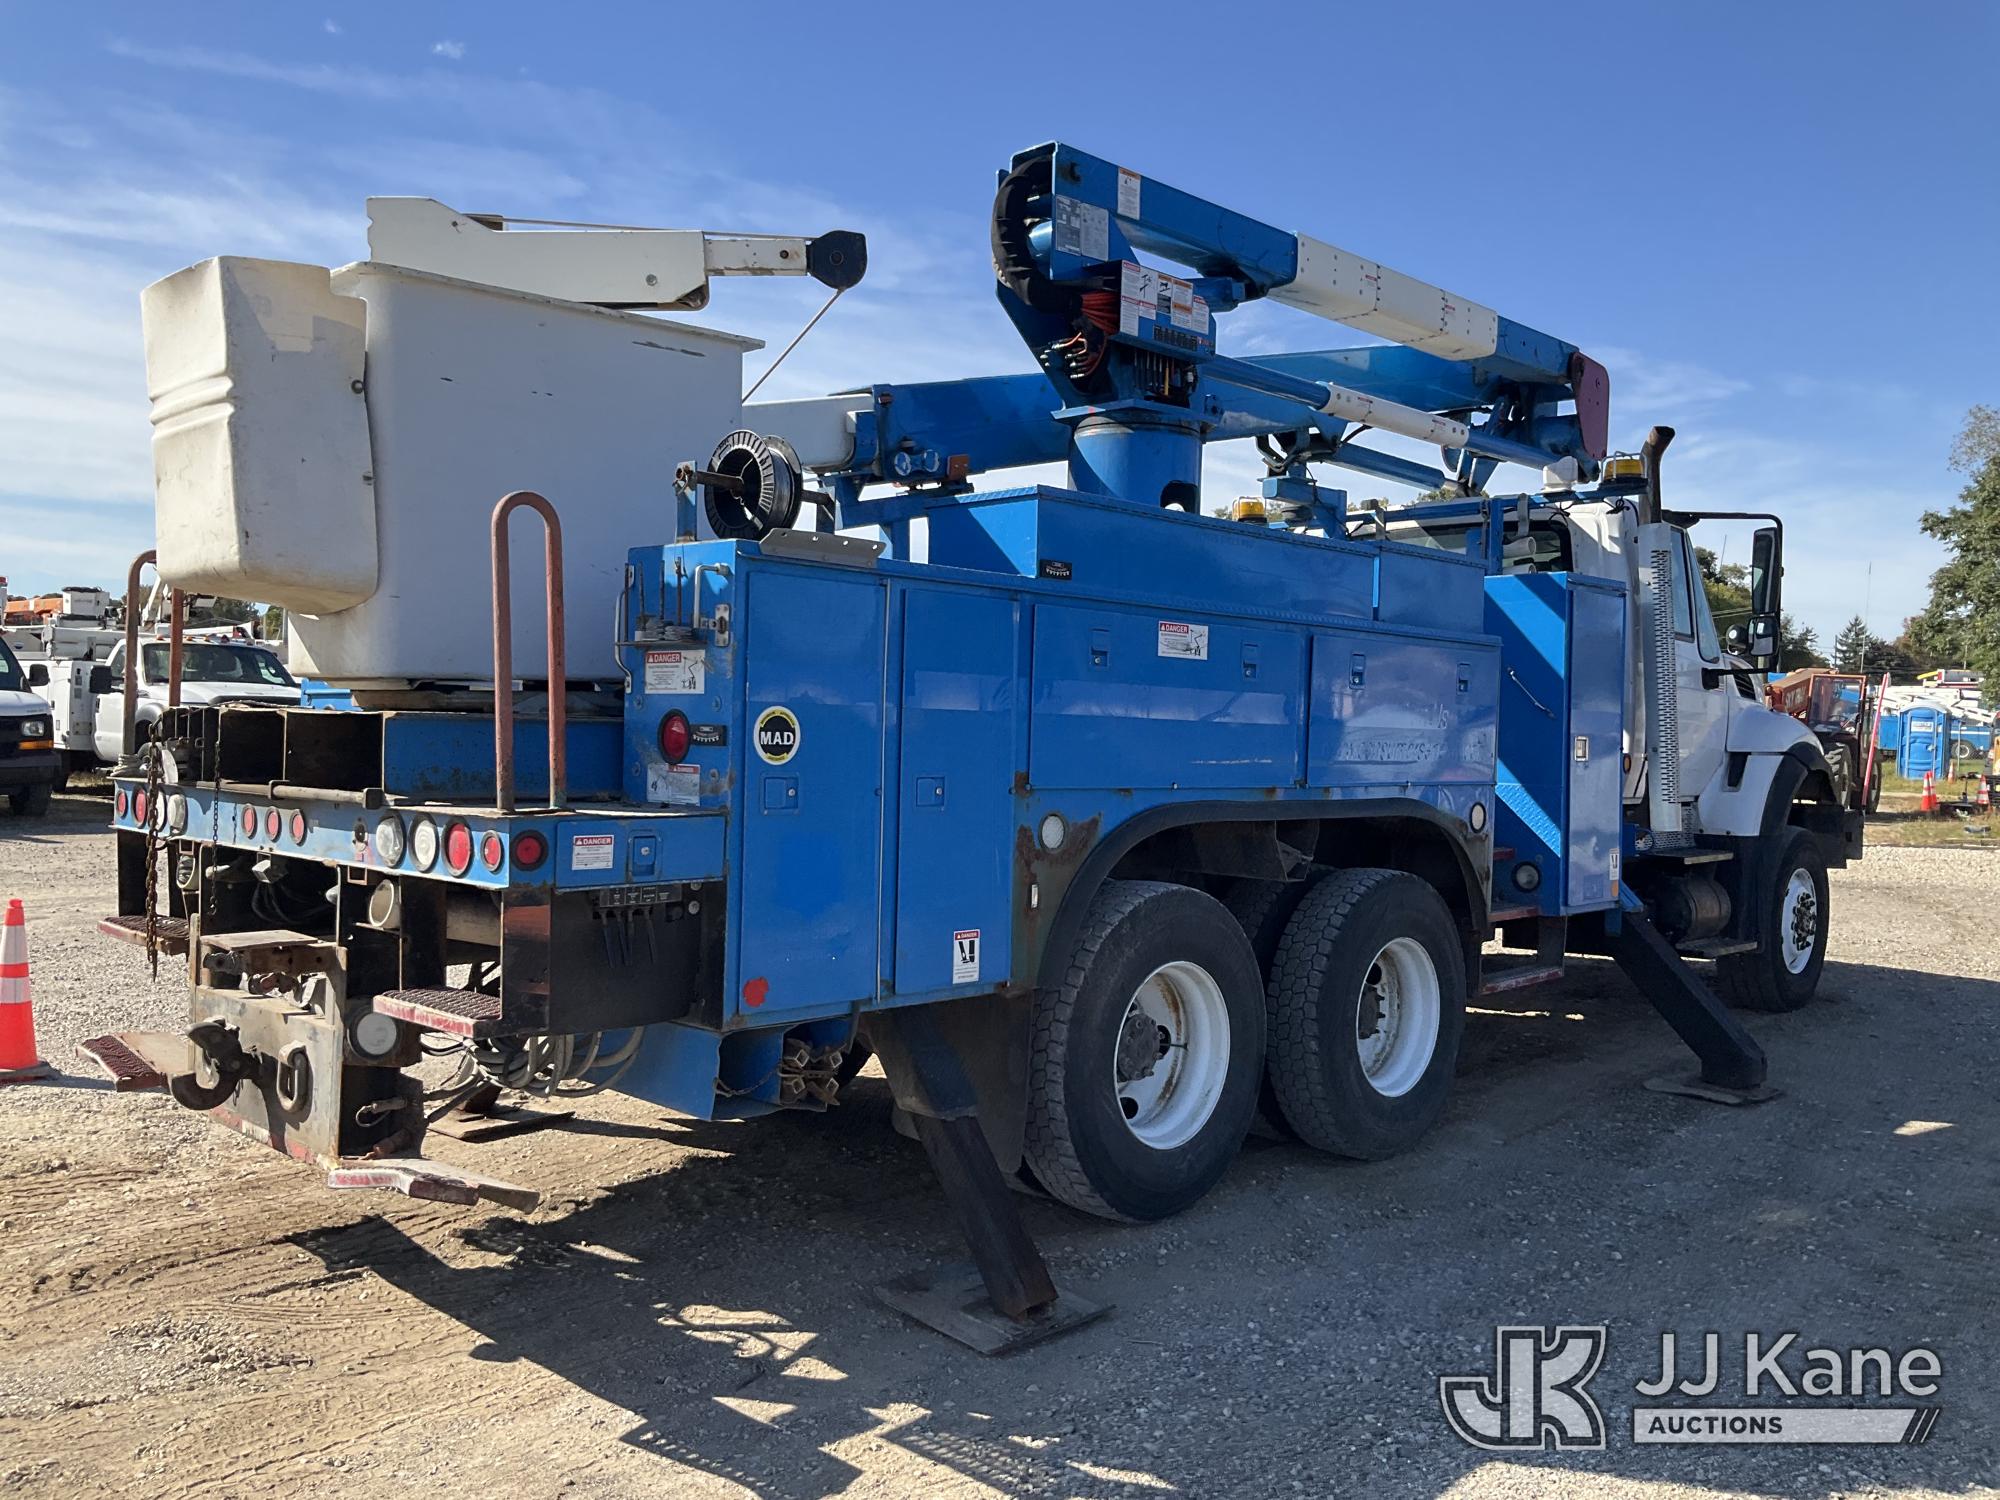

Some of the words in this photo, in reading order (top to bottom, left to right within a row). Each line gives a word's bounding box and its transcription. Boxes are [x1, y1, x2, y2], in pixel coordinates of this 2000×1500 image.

[1165, 625, 1188, 633] DANGER
[654, 653, 681, 663] DANGER
[583, 837, 612, 845] DANGER
